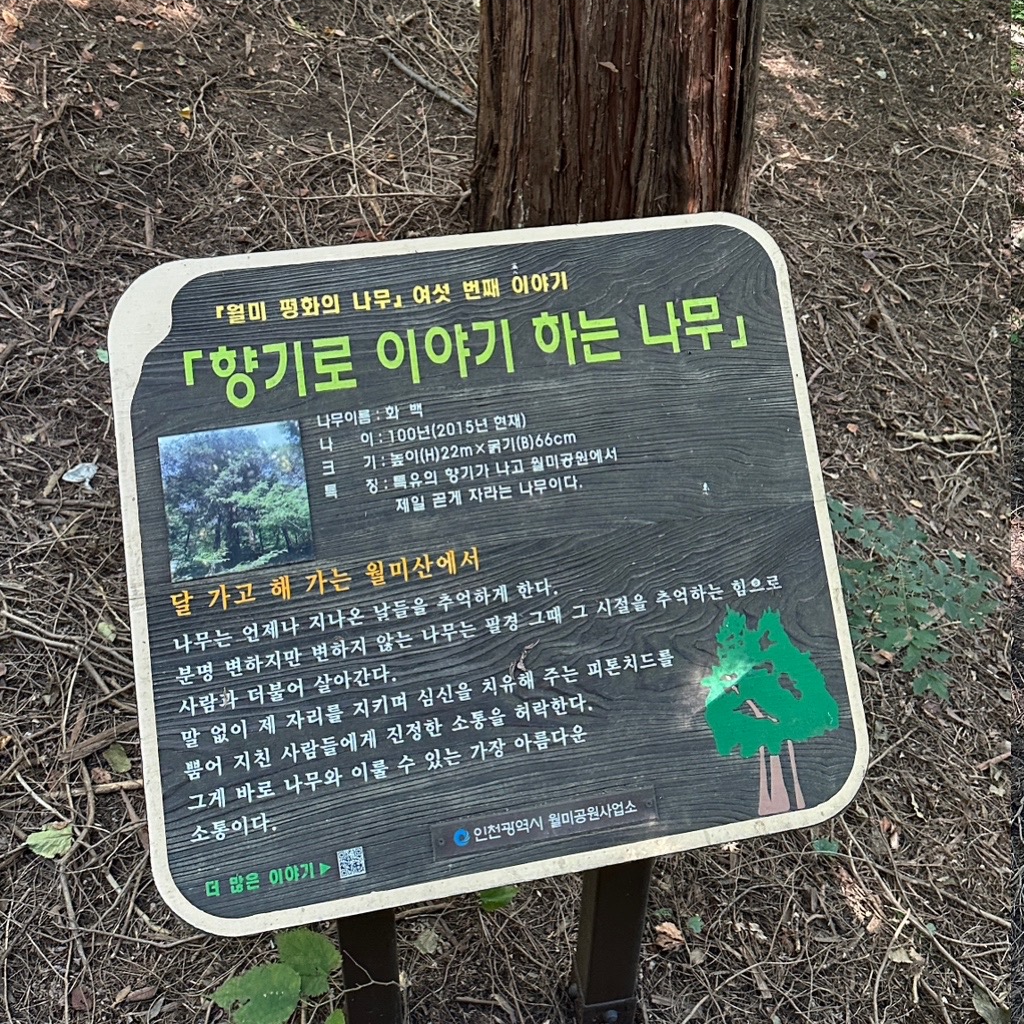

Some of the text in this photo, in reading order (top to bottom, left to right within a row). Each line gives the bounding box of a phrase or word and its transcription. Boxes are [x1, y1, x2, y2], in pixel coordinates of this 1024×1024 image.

[280, 294, 340, 320] 평화의
[413, 283, 451, 304] 여섯
[463, 278, 500, 301] 번째
[512, 271, 568, 294] 이야기
[377, 319, 515, 384] 이야기
[532, 311, 621, 365] 하는
[639, 297, 747, 353] 나무」
[493, 412, 526, 430] 현재)
[445, 463, 489, 484] 향기가
[496, 459, 524, 476] 나고
[530, 447, 617, 472] 월미공원에서
[395, 475, 583, 513] 제일 곧게 자라는 나무이다.
[170, 547, 480, 617] 달 가고 해 가는 월미산에서
[173, 578, 558, 654] 나무는 언제나 지나온 날들을 추억하게 한다.
[176, 661, 213, 686] 분명
[225, 647, 302, 678] 변하지만
[311, 637, 367, 662] 변하지
[376, 627, 413, 653] 않는
[421, 619, 476, 646] 나무는
[529, 606, 562, 626] 그때
[571, 604, 588, 620] 그
[597, 593, 647, 617] 시절을
[656, 583, 724, 608] 추억하는
[731, 574, 783, 597] 힘으로
[178, 665, 397, 717] 사람과 더불어 살아간다.
[180, 649, 674, 749] 말 없이 제 자리를 지키며 심신을 치유해 주는 피톤치드를
[184, 694, 593, 781] 뿜어 지친 사람들에게 진정한 소통을 허락한다.
[187, 724, 587, 810] 그게 바로 나무와 이룰 수 있는 가장 아름다운
[190, 812, 276, 842] 소통이다.
[473, 801, 637, 842] 인천광역시 월미공원사업소
[206, 862, 315, 897] 더 많은 이야기
